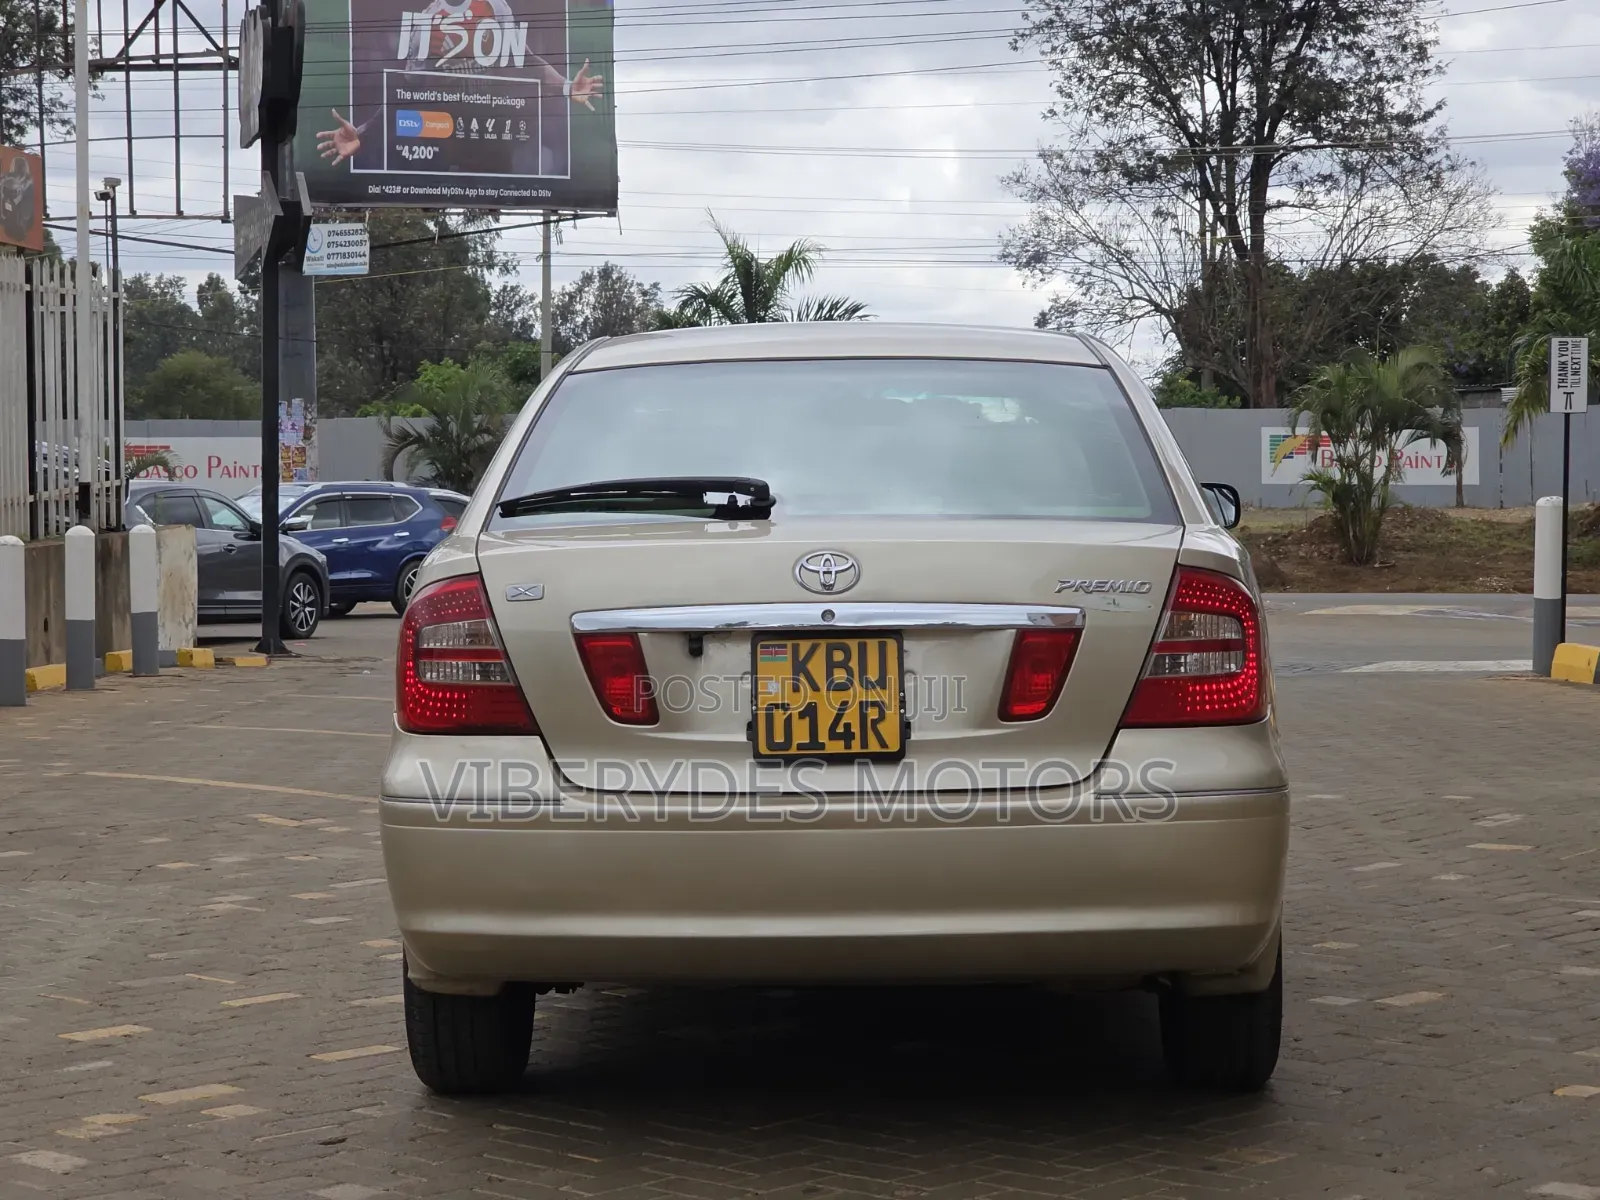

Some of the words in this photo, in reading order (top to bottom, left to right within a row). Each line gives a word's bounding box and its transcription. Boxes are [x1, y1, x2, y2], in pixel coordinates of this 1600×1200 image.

[473, 18, 529, 69] ON
[396, 89, 412, 100] The
[412, 90, 442, 102] world's
[443, 91, 461, 102] best
[461, 92, 491, 105] football
[492, 96, 526, 109] package
[398, 119, 420, 128] DStv
[402, 145, 434, 161] 4,200
[368, 185, 381, 194] Dial
[410, 186, 441, 195] Download
[442, 187, 465, 197] MyDStv
[465, 188, 478, 198] App
[478, 188, 485, 196] to
[485, 188, 498, 198] stay
[499, 188, 531, 197] Connected
[531, 189, 538, 197] to
[538, 189, 552, 197] DStv
[1557, 340, 1569, 358] YOU
[1570, 339, 1582, 355] TIME
[1557, 360, 1569, 389] THANK
[1570, 356, 1582, 376] NEXT
[1570, 377, 1581, 388] TILL
[1054, 579, 1153, 594] PREMIO
[791, 640, 888, 693] KBU
[765, 699, 890, 751] 014R
